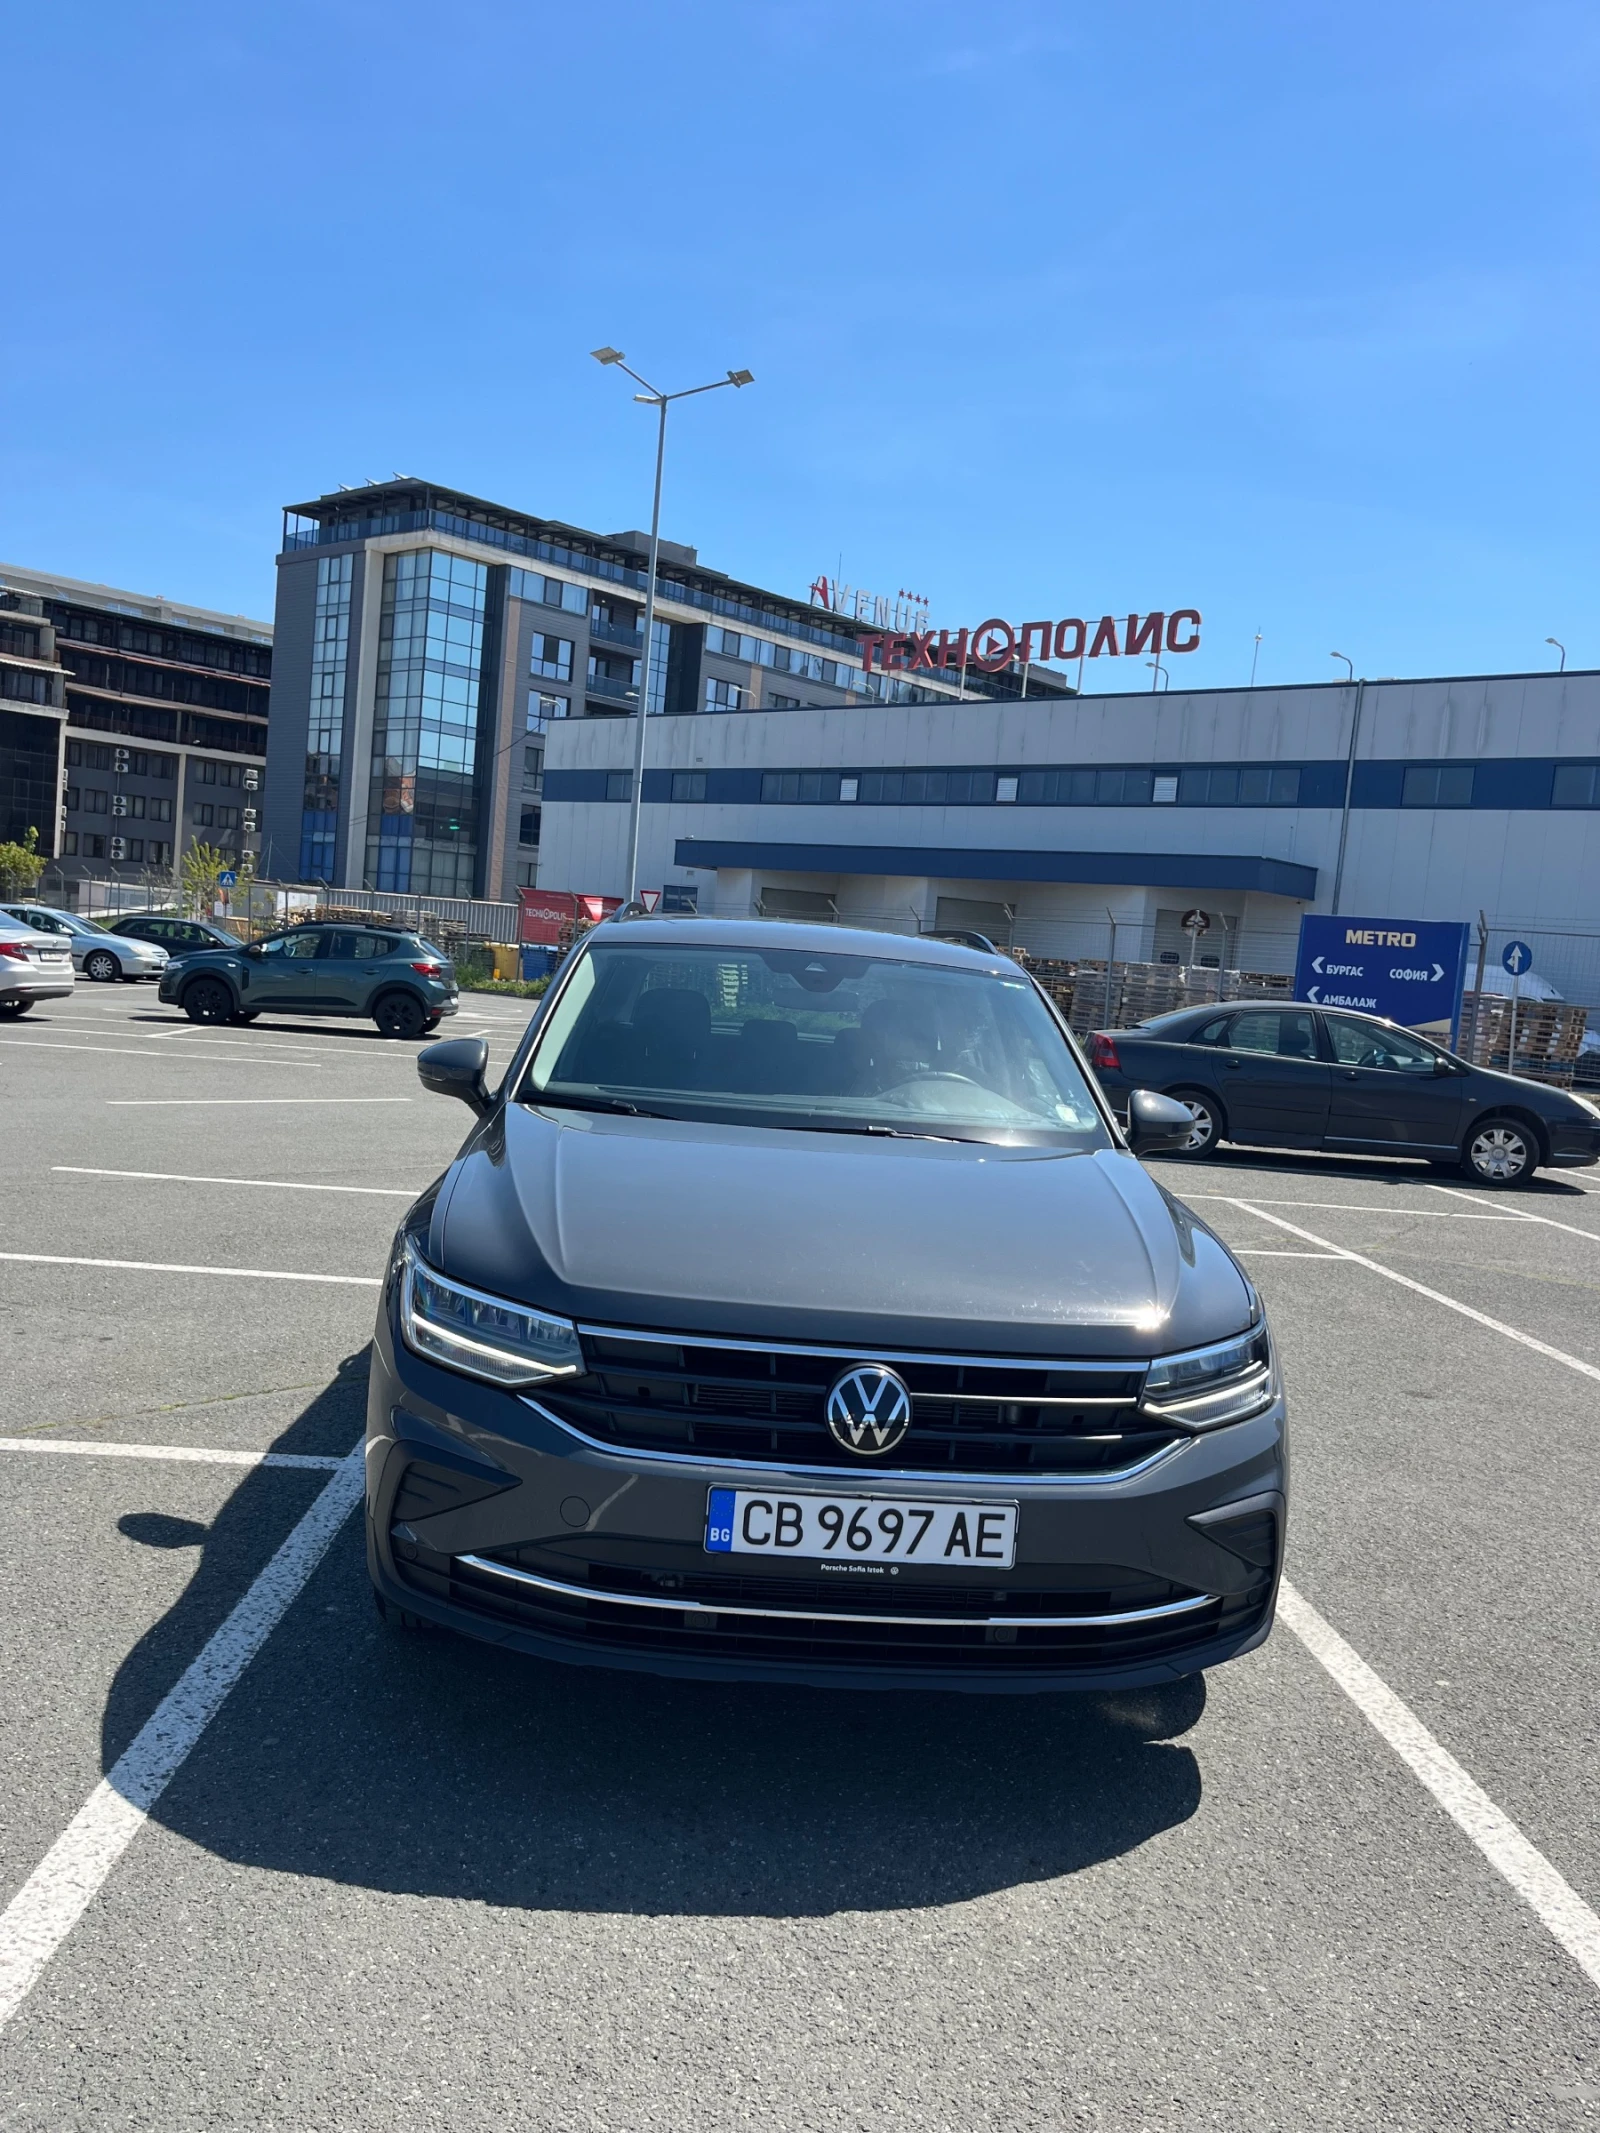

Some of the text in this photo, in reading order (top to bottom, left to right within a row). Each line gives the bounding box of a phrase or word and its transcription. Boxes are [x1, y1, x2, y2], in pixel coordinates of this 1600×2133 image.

[809, 576, 930, 634] AVENUE
[857, 609, 1202, 672] ТЕХНОПОЛИС
[1345, 929, 1416, 948] METRO
[1326, 964, 1364, 977] БУРГАС
[1389, 968, 1428, 981] СОФИЯ
[1322, 994, 1377, 1008] АМБАЛАЖ
[709, 1527, 730, 1542] BG
[818, 1505, 935, 1555] 9697
[821, 1563, 885, 1574] Porsche Sofia Iztok
